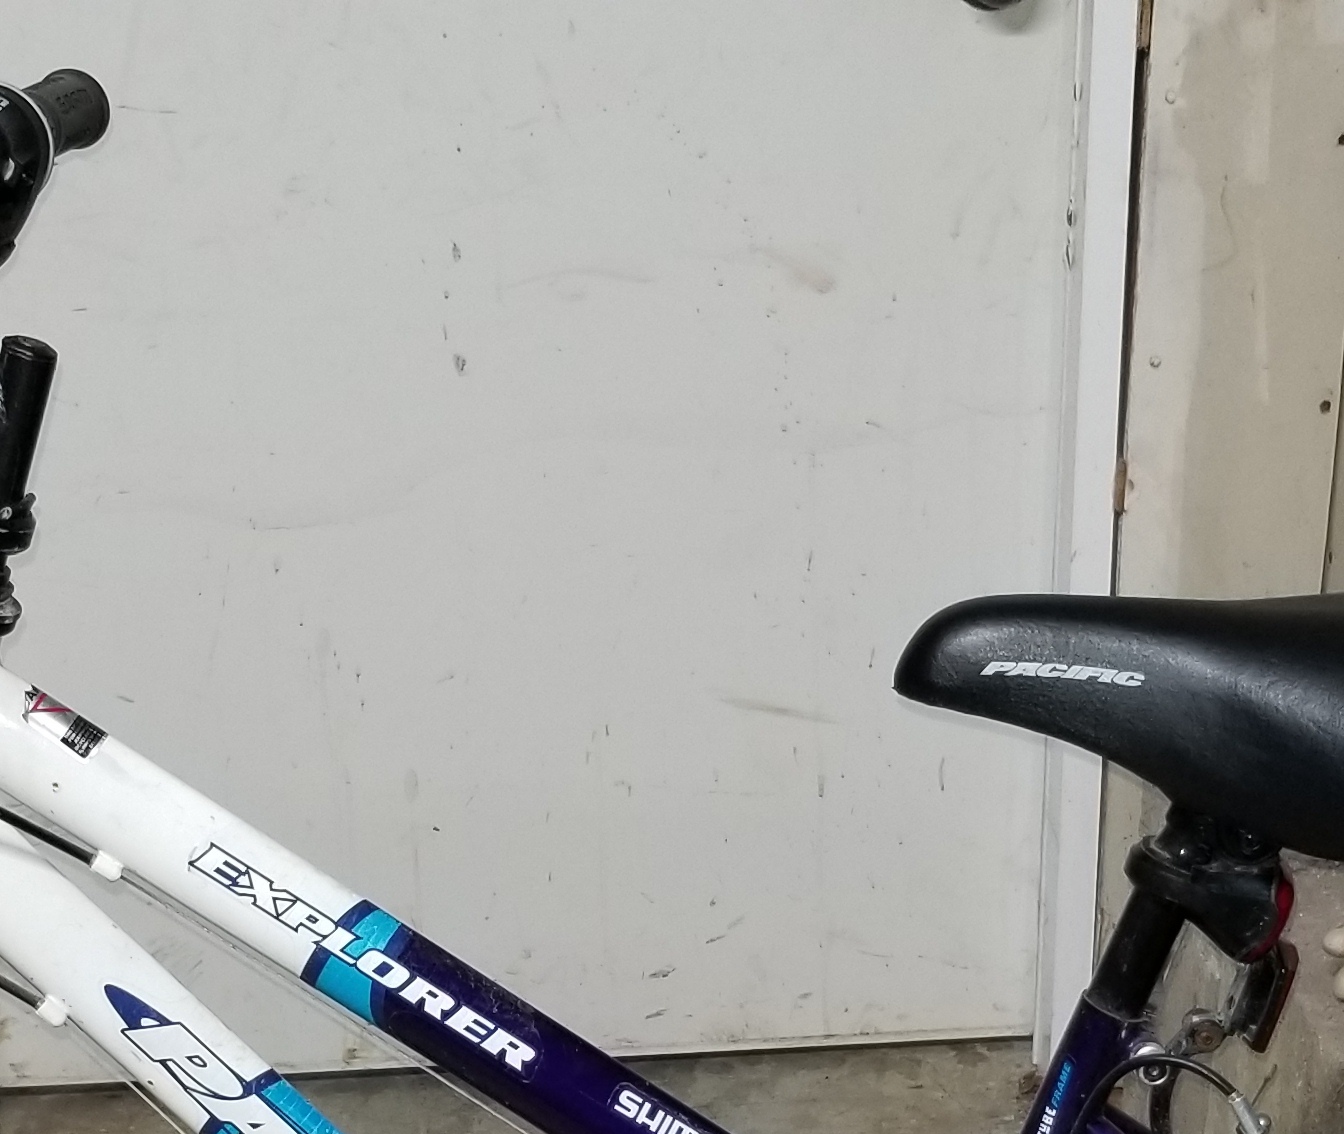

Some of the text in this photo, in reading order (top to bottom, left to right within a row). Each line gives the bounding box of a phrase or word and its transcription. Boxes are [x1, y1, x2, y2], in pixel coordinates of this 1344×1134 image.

[980, 661, 1145, 687] PACIFIC
[189, 842, 537, 1072] EXPLORER
[1051, 1062, 1071, 1107] FRAME
